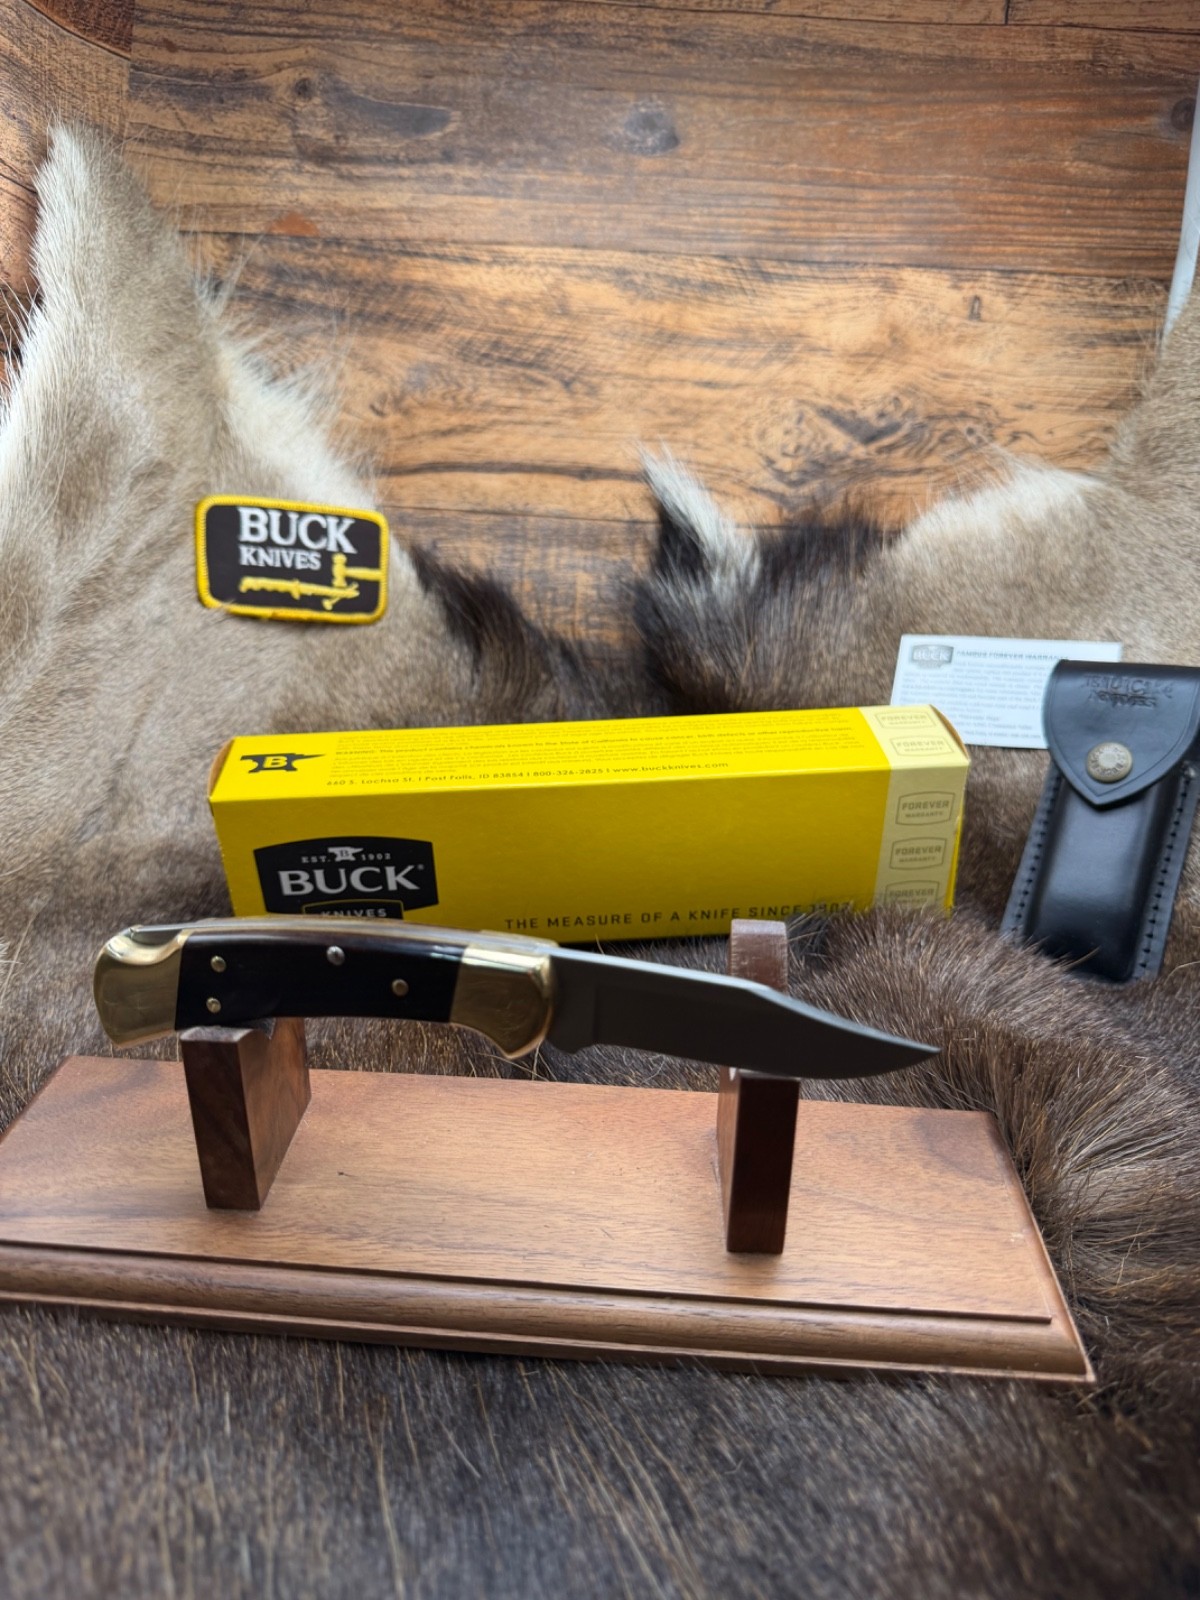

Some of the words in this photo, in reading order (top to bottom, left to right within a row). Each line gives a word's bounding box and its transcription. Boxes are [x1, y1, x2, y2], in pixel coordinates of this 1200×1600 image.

[237, 506, 357, 554] BUCK
[239, 545, 322, 571] KNIVES
[612, 762, 729, 774] www.buckknives.com
[902, 800, 949, 810] FOREVER
[895, 846, 942, 855] FOREVER
[302, 855, 331, 863] EST.
[361, 853, 391, 861] 1902
[505, 917, 538, 929] THE
[547, 913, 632, 928] MEASURE
[641, 911, 662, 924] OF
[670, 911, 680, 921] A
[689, 907, 740, 921] KNIFE
[748, 904, 804, 918] SINCE
